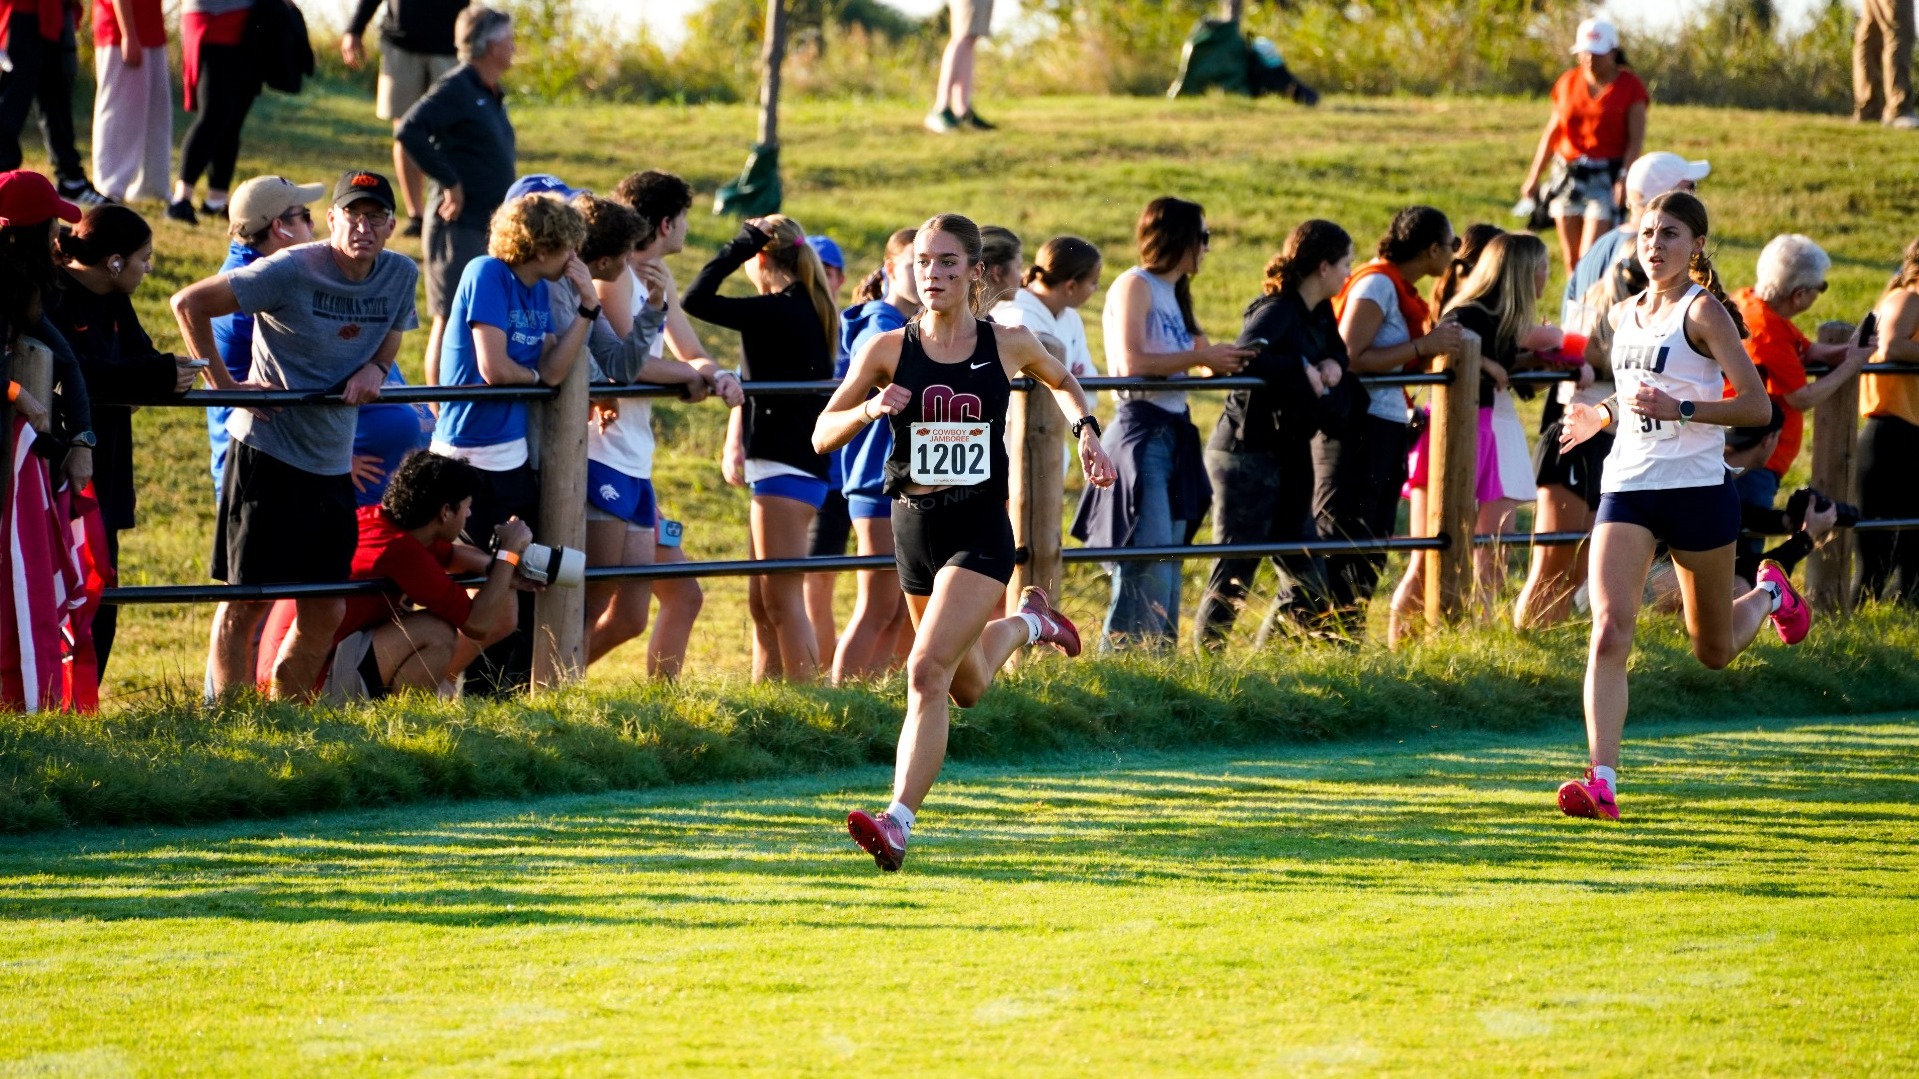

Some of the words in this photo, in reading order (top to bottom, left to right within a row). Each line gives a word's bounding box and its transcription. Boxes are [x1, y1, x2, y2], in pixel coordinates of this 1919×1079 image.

[312, 289, 362, 315] OKLAHOMA
[363, 296, 388, 315] STATE
[930, 435, 970, 443] JAMBOREE
[932, 428, 967, 436] COWBOY
[917, 443, 985, 475] 1202
[899, 492, 936, 510] PRO
